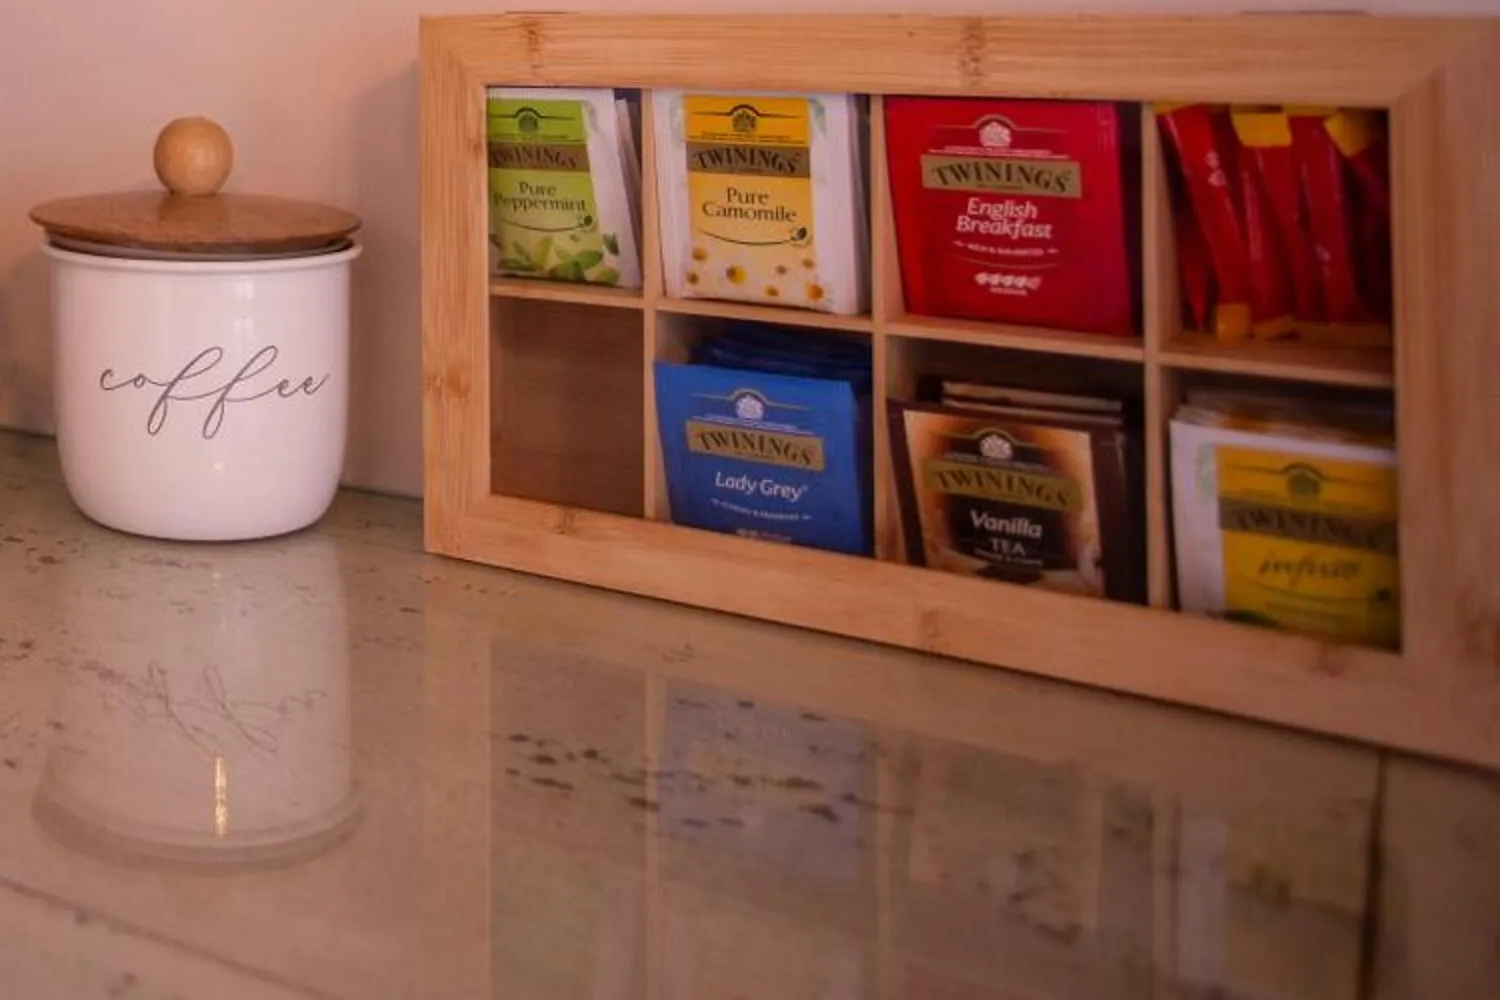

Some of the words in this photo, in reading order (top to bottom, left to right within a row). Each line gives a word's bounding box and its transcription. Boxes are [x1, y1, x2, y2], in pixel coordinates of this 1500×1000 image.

[693, 146, 800, 174] TWININGS
[518, 181, 558, 197] Pure
[931, 160, 1073, 194] TWININGS
[726, 186, 771, 205] Pure
[966, 196, 1039, 221] English
[701, 200, 798, 223] Camomile
[954, 214, 1054, 241] Breakfast
[99, 345, 330, 440] coffee
[696, 429, 816, 467] TWININGS
[714, 470, 757, 495] Lady
[934, 469, 1072, 508] TWININGS
[969, 508, 1043, 539] Vanilla
[989, 537, 1026, 557] TEA
